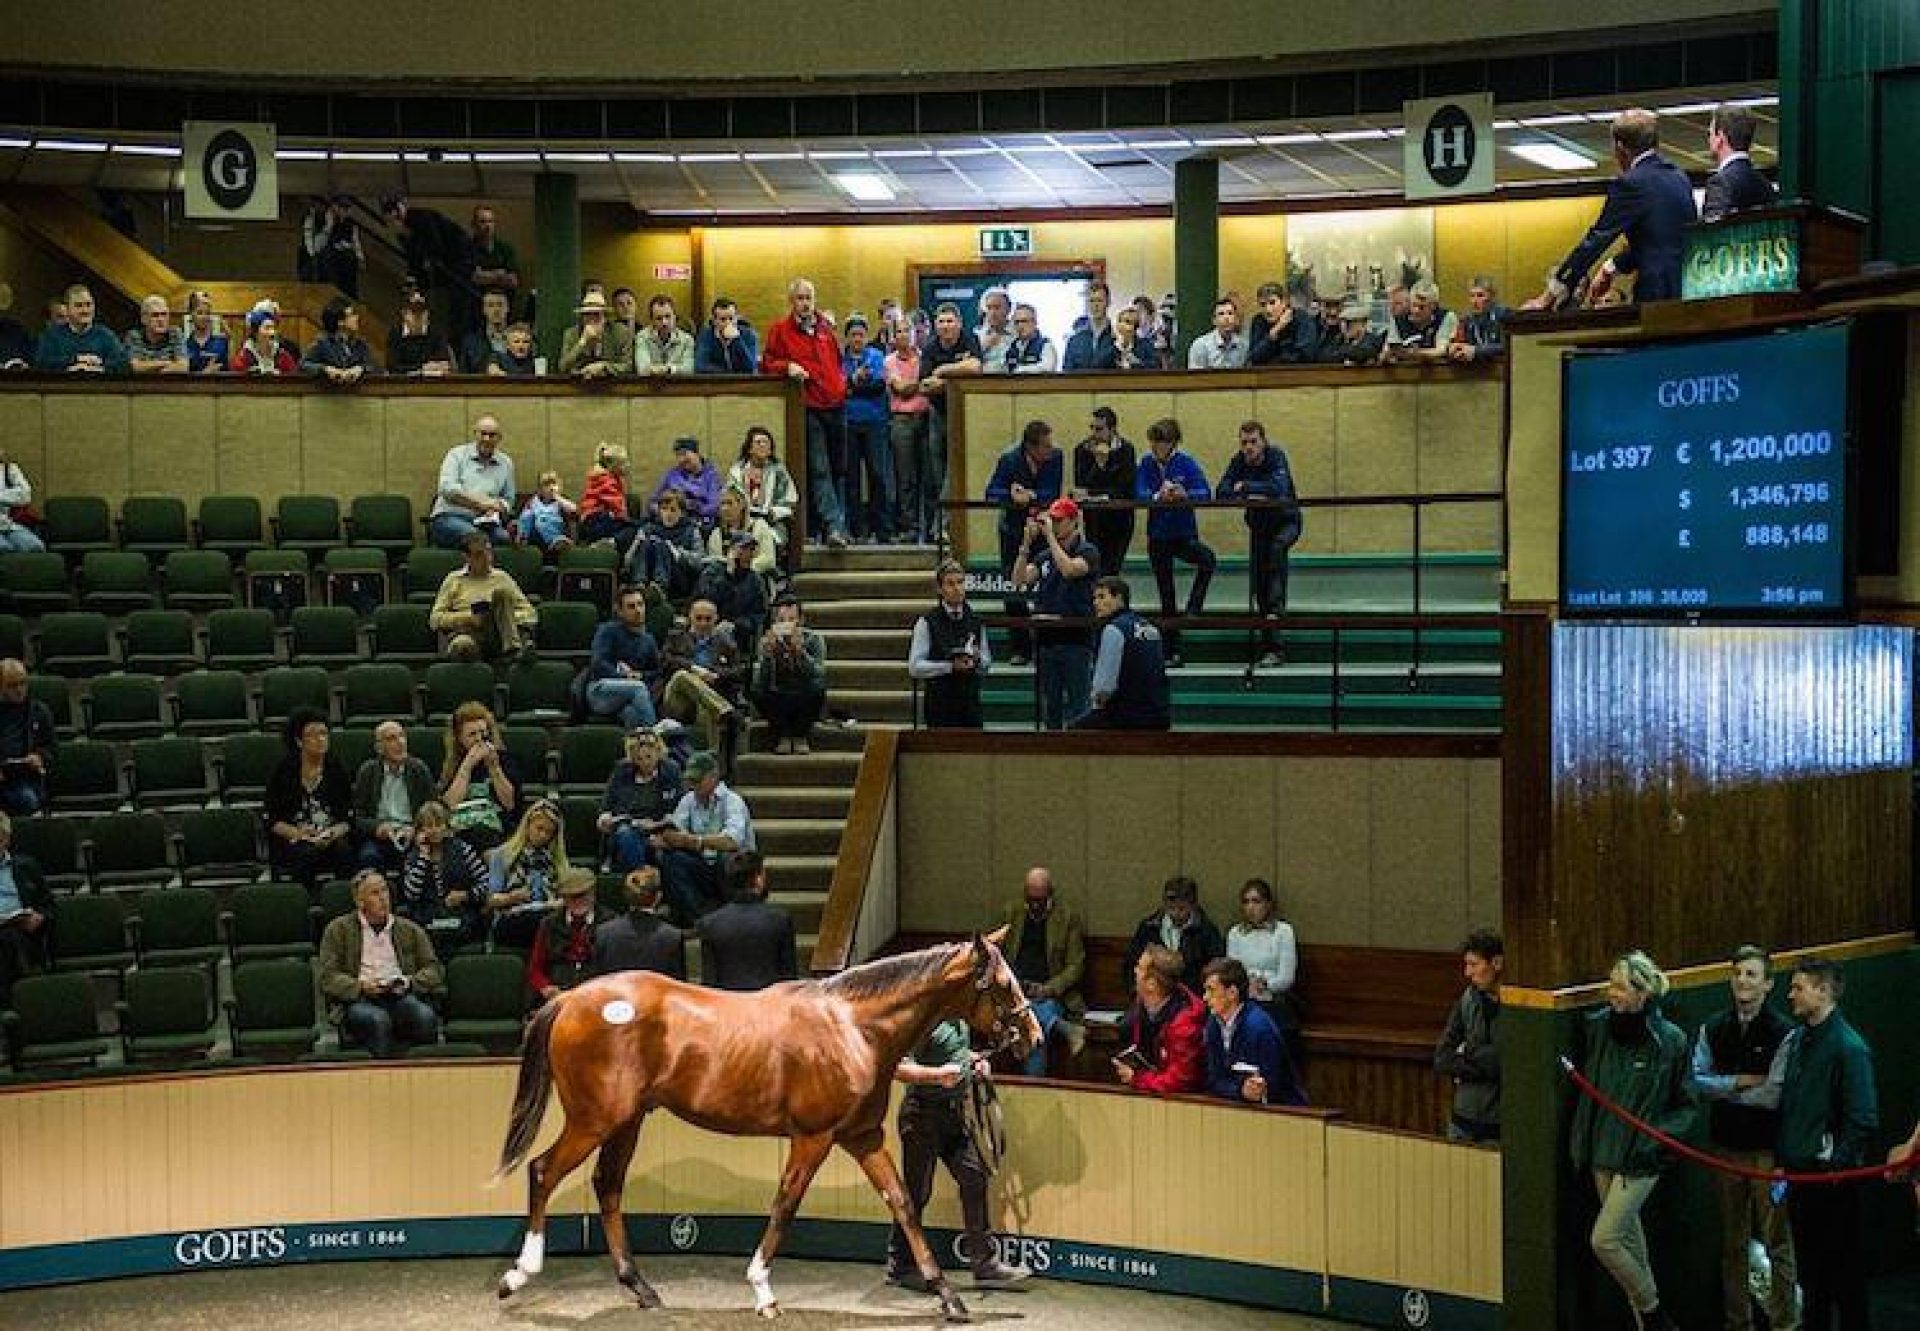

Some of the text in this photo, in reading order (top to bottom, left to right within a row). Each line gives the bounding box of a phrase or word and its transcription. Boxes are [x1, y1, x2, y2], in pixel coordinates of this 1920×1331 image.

[1431, 125, 1467, 170] H
[211, 149, 248, 190] G
[1689, 237, 1788, 283] GOFFS
[1658, 373, 1740, 408] GOFFS
[1571, 451, 1606, 472] Lot
[1612, 445, 1652, 469] 397
[1709, 430, 1832, 467] 1,200,000
[176, 1228, 408, 1265] GOFFS SINCE 1866
[1070, 1253, 1117, 1273] SINCE
[1124, 1260, 1158, 1277] 1866
